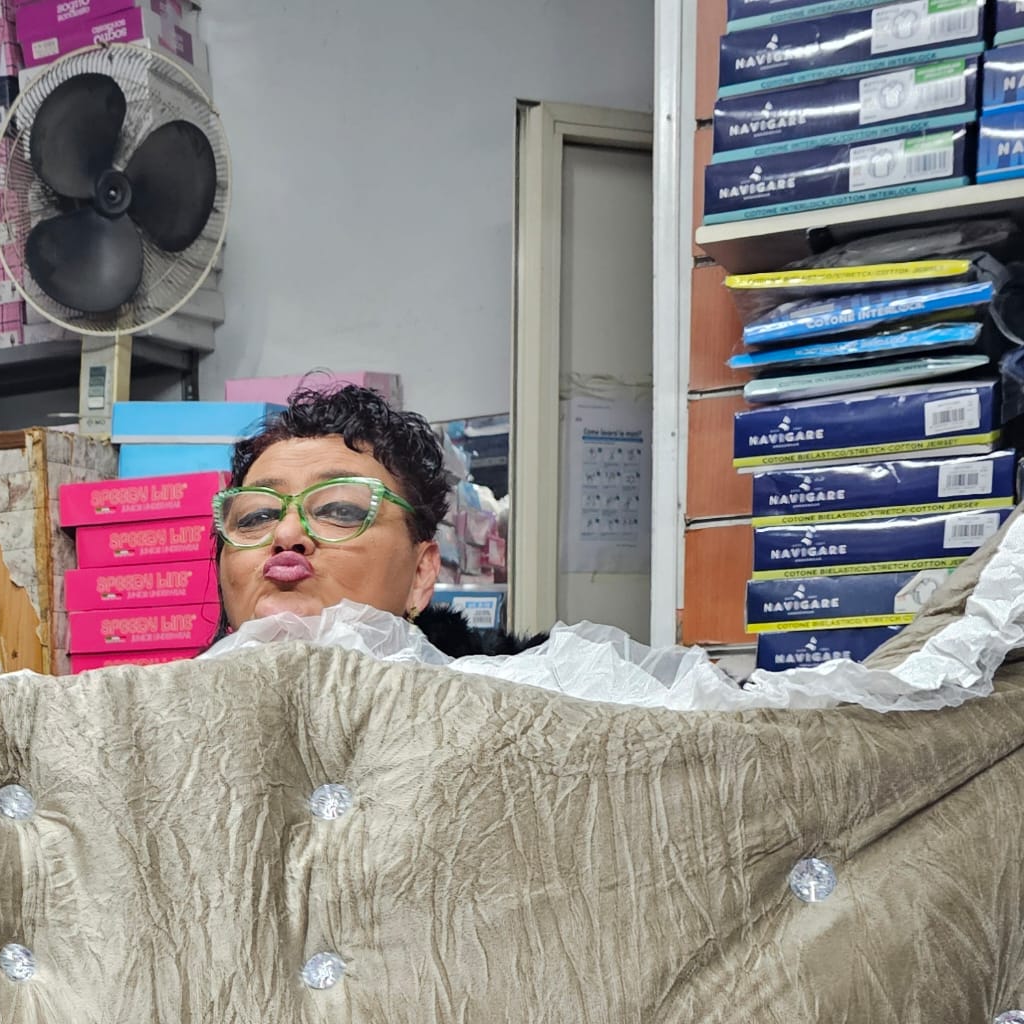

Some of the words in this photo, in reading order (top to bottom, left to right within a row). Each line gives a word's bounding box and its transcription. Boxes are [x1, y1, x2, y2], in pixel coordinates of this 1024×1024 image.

[729, 113, 807, 137] NAVIGARE
[719, 178, 796, 200] NAVIGARE
[749, 428, 824, 447] NAVIGARE
[762, 454, 796, 464] COTONE
[769, 489, 845, 506] NAVIGARE
[782, 515, 816, 524] COTONE
[770, 544, 847, 560] NAVIGARE
[784, 569, 818, 578] COTONE
[911, 558, 946, 568] COTTON
[763, 597, 840, 613] NAVIGARE
[775, 650, 851, 664] NAVIGARE
